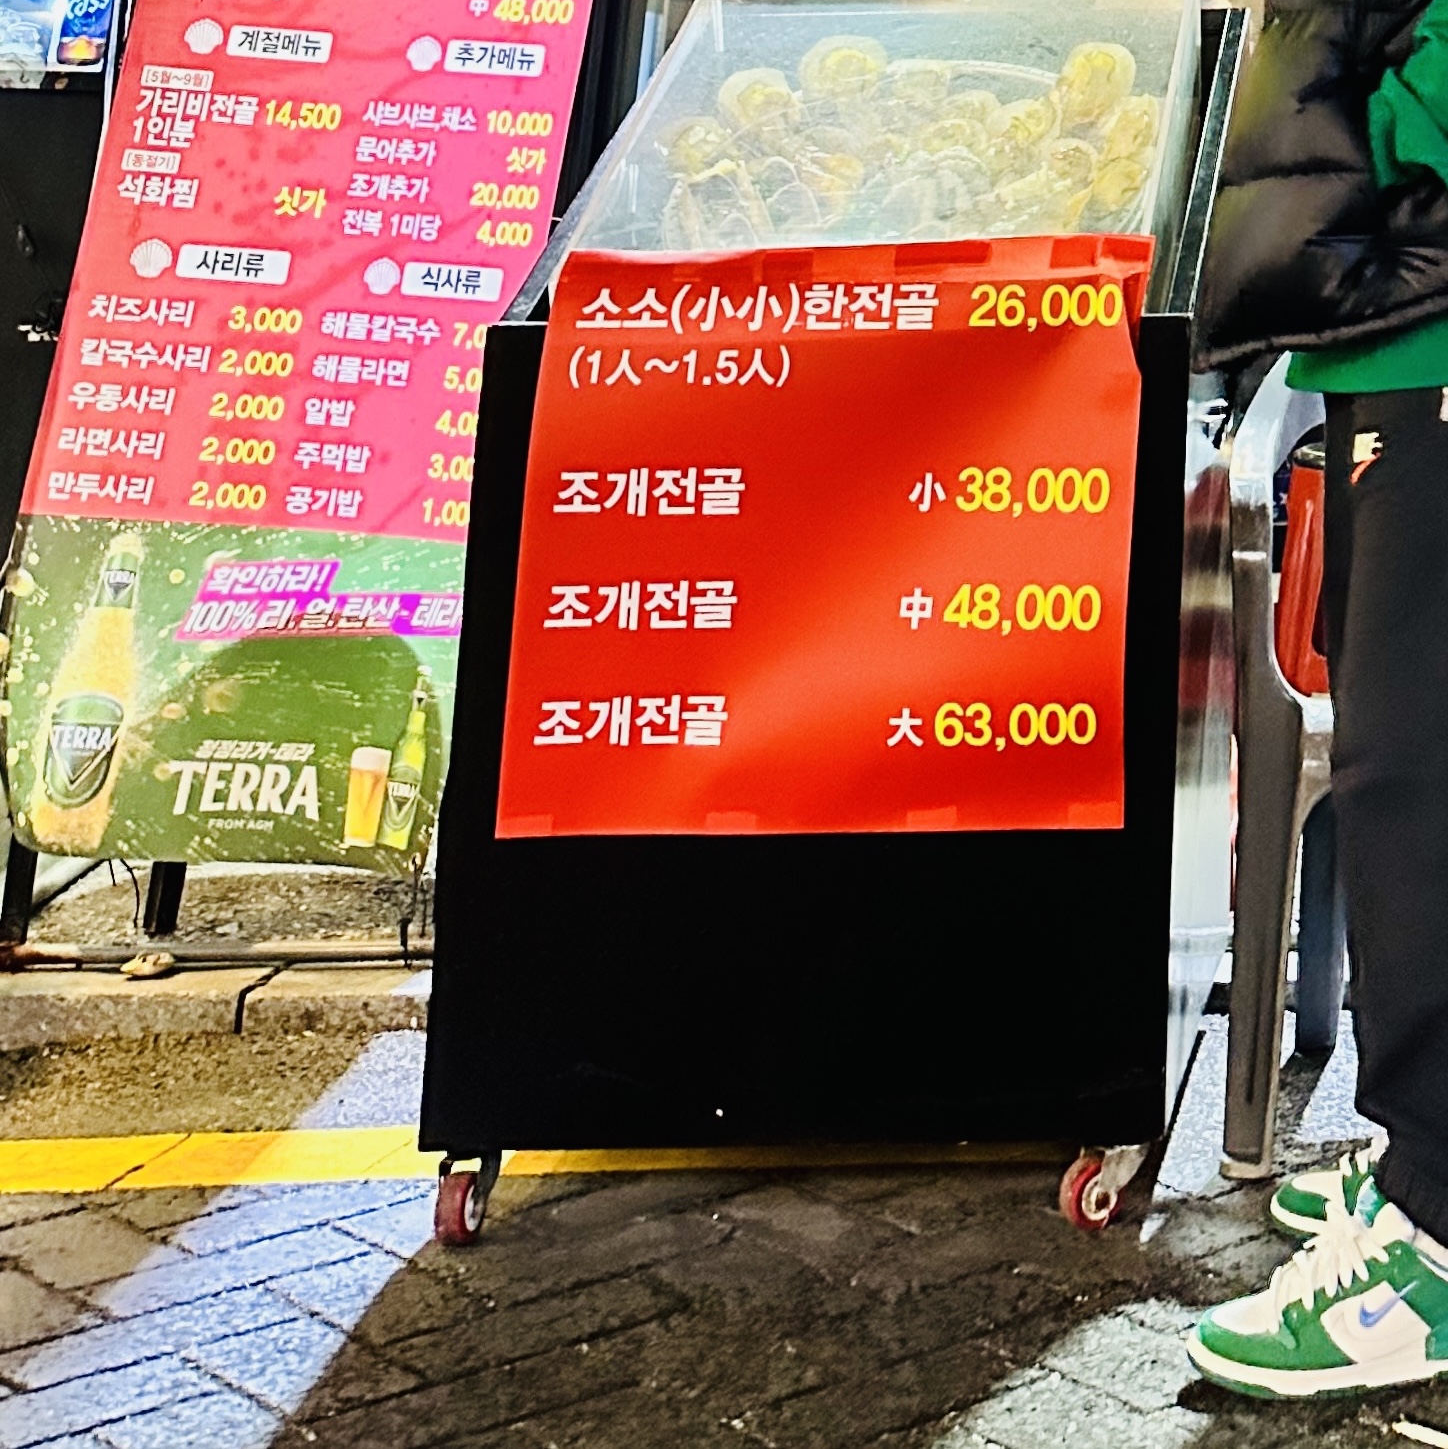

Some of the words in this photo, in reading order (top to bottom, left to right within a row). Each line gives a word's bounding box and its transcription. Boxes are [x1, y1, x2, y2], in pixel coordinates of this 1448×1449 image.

[237, 30, 323, 58] 계절메뉴
[454, 43, 536, 72] 추가메뉴
[135, 88, 259, 126] 가리비전골
[265, 100, 342, 131] 14,500
[487, 109, 553, 138] 10,000
[133, 116, 196, 148] 1인분
[356, 136, 437, 166] 문어추가
[506, 147, 546, 175] 싯가
[118, 174, 199, 209] 석화찜
[274, 186, 327, 219] 싯가
[347, 173, 430, 203] 조개추가
[469, 182, 539, 211] 20,000
[341, 209, 383, 237] 전복
[476, 220, 533, 248] 4,000
[196, 250, 265, 278] 사리류
[421, 266, 482, 295] 식사류
[88, 294, 195, 328] 치즈사리
[228, 305, 303, 335] 3,000
[574, 282, 941, 334] 소소(小小)한전골
[968, 283, 1122, 333] 26,000
[321, 311, 442, 346] 해물칼국수
[452, 322, 488, 350] 7,0
[80, 338, 212, 373] 칼국수사리
[218, 348, 294, 377] 2,000
[312, 354, 411, 388] 해물라면
[443, 366, 482, 393] 5,0
[68, 381, 177, 416] 우동사리
[208, 392, 285, 422] 2,000
[305, 398, 355, 428] 알밥
[435, 410, 479, 438] 4,0
[58, 427, 166, 461] 라면사리
[198, 437, 276, 466] 2,000
[294, 441, 372, 474] 주먹밥
[427, 453, 475, 483] 3,00
[48, 471, 155, 505] 만두사리
[188, 481, 267, 510] 2,000
[286, 485, 363, 519] 공기밥
[422, 497, 471, 528] 1,00
[552, 467, 746, 517] 조개전골
[908, 472, 946, 513] 小
[955, 467, 1111, 517] 38,000
[207, 564, 332, 594] 확인하라!
[543, 580, 738, 631] 조개전골
[900, 587, 934, 631] 中
[943, 584, 1102, 636] 48,000
[52, 725, 114, 752] TERRA
[533, 694, 729, 746] 조개전골
[887, 708, 923, 748] 大
[934, 702, 1097, 752] 63,000
[169, 760, 321, 822] TERRA
